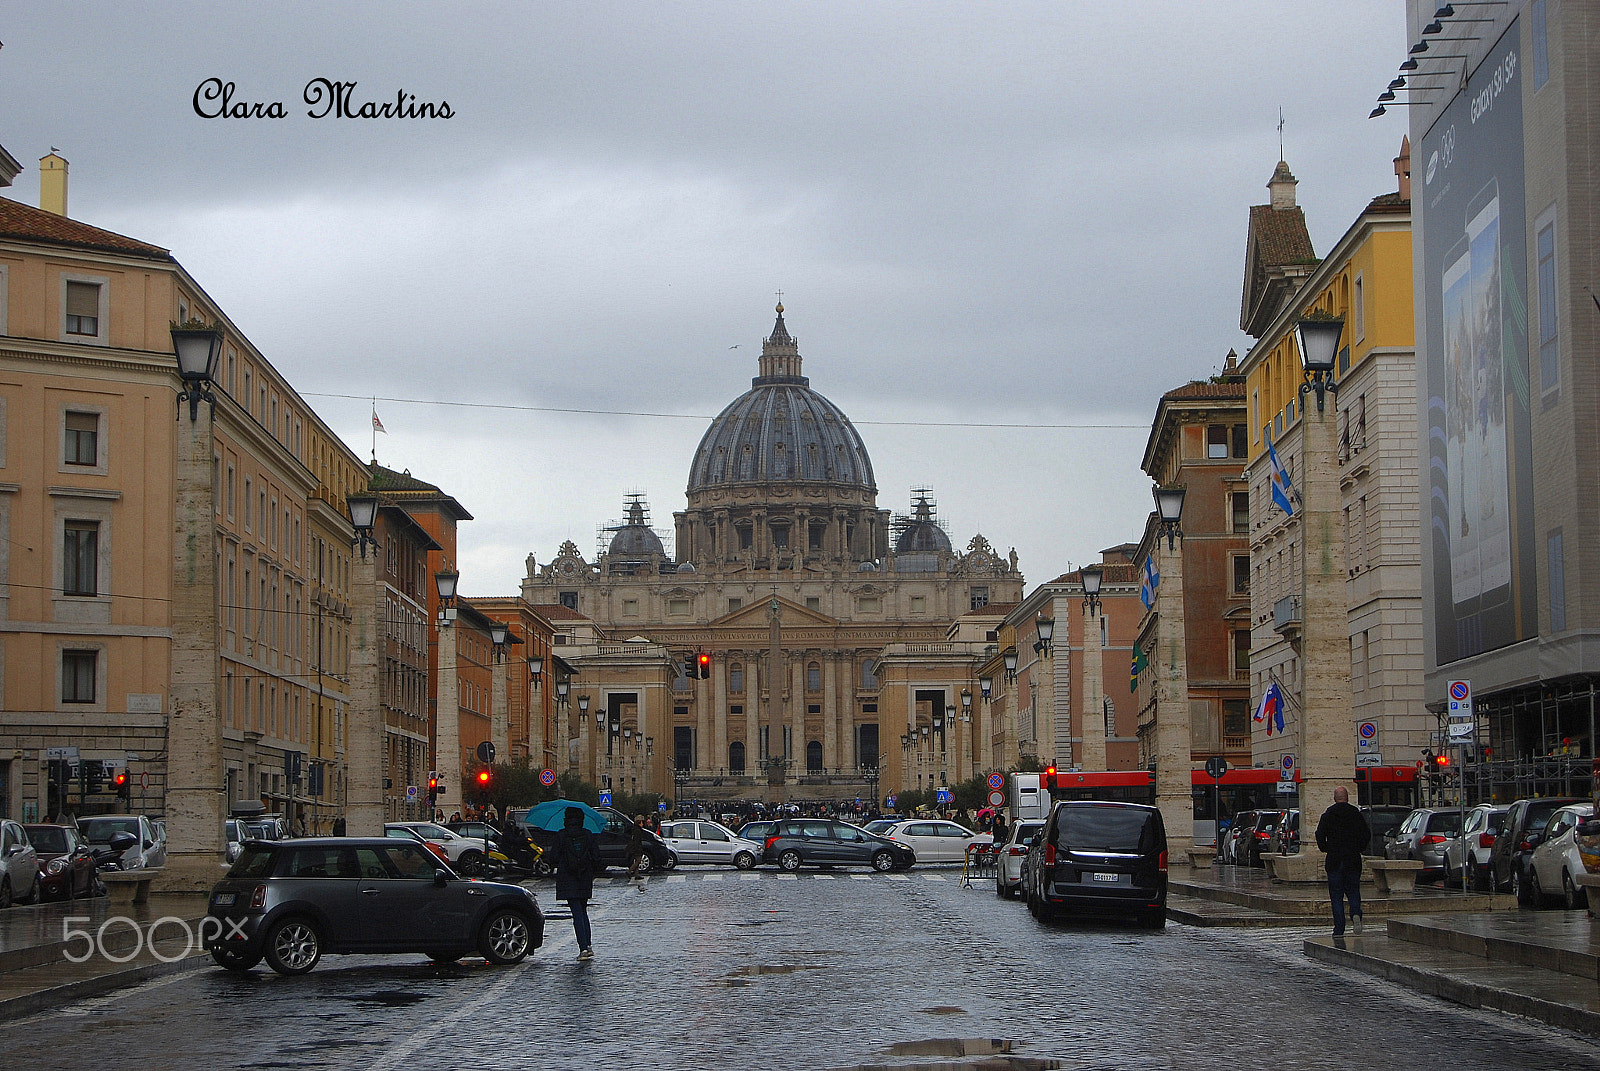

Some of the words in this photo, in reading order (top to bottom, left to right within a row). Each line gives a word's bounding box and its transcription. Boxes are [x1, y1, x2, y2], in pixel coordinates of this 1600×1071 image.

[1471, 80, 1493, 124] Galaxy
[1494, 65, 1502, 98] S8
[1505, 50, 1516, 84] S8+
